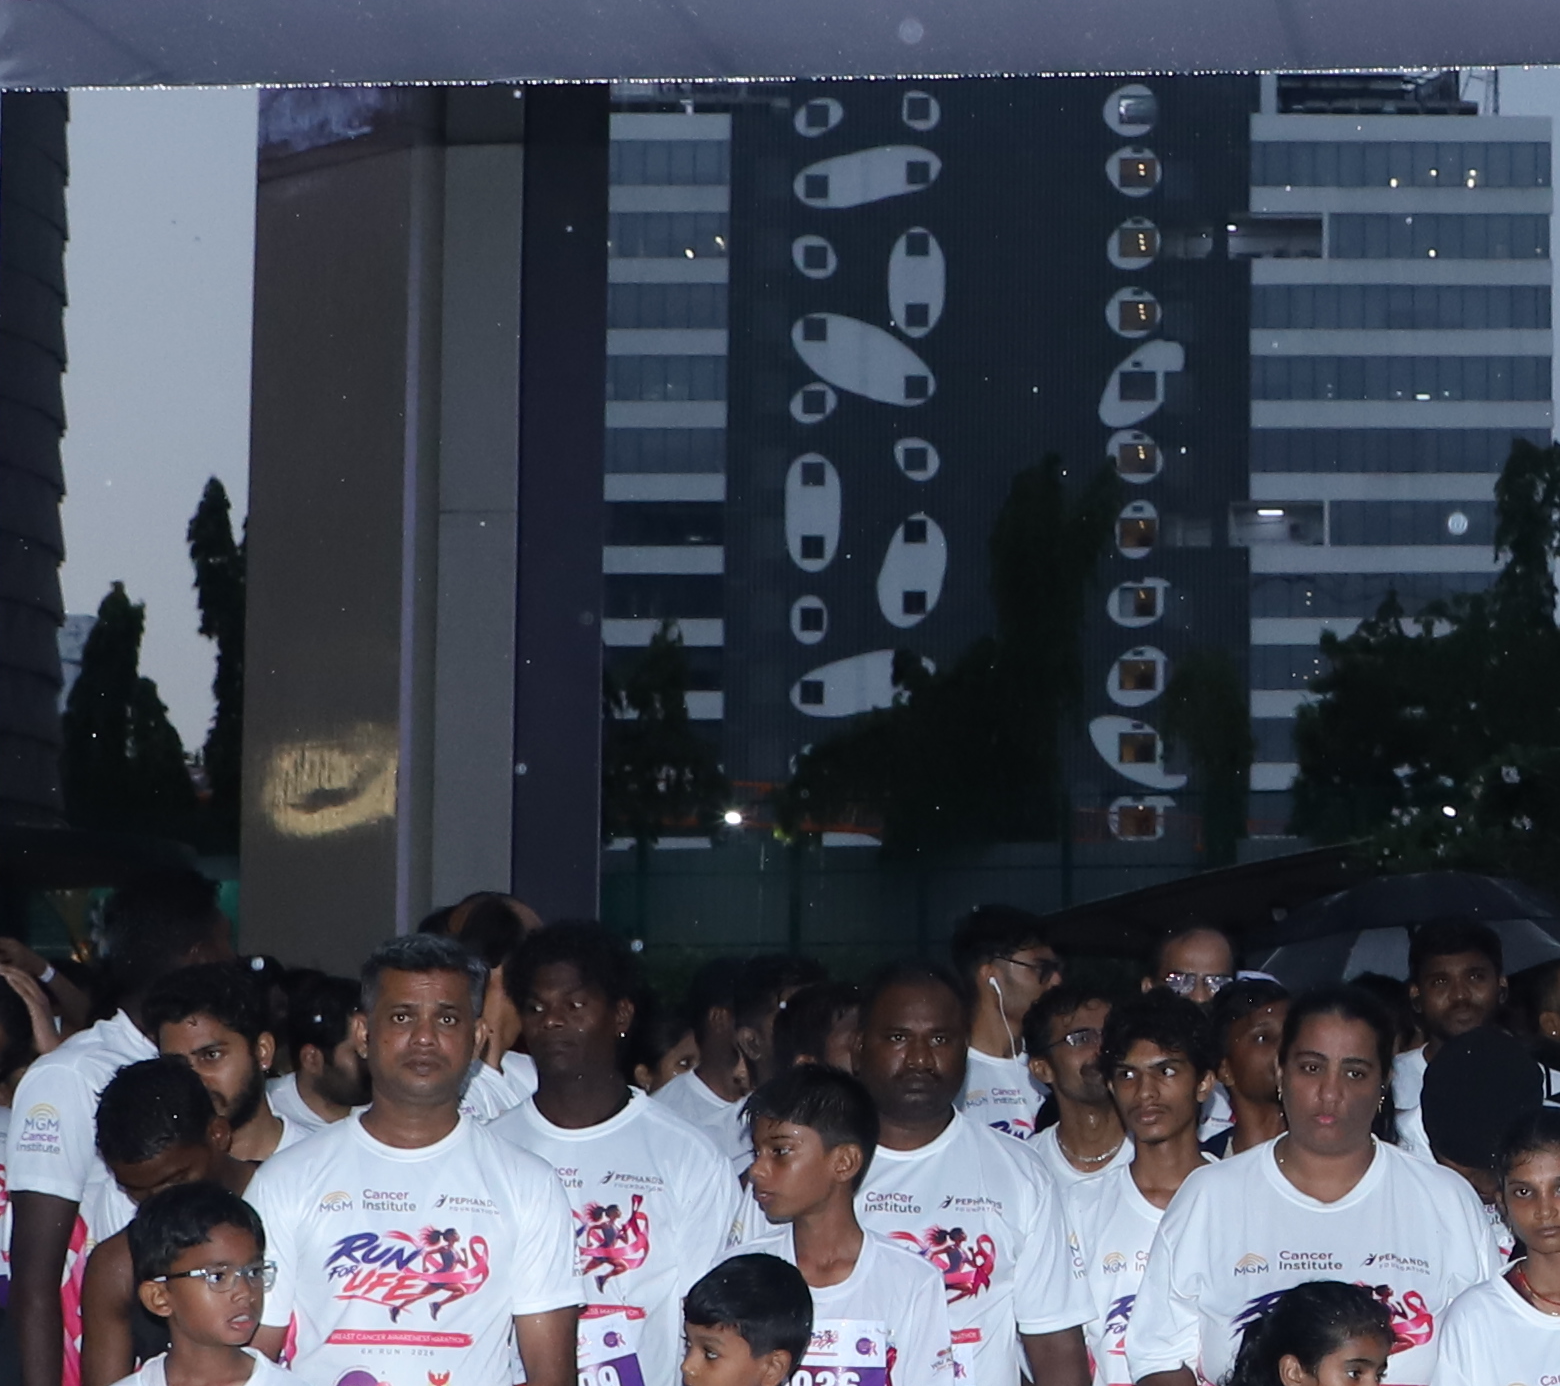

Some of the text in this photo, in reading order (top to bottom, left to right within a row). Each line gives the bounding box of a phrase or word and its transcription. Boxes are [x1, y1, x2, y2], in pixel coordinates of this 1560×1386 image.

[24, 1118, 59, 1131] MGM
[21, 1133, 59, 1142] Cancer
[17, 1142, 60, 1153] Institute
[363, 1189, 409, 1200] Cancer
[320, 1200, 416, 1212] MGM Institute
[323, 1232, 425, 1272] RUN
[1279, 1250, 1333, 1260] Cancer
[1234, 1262, 1343, 1276] MGM Institute
